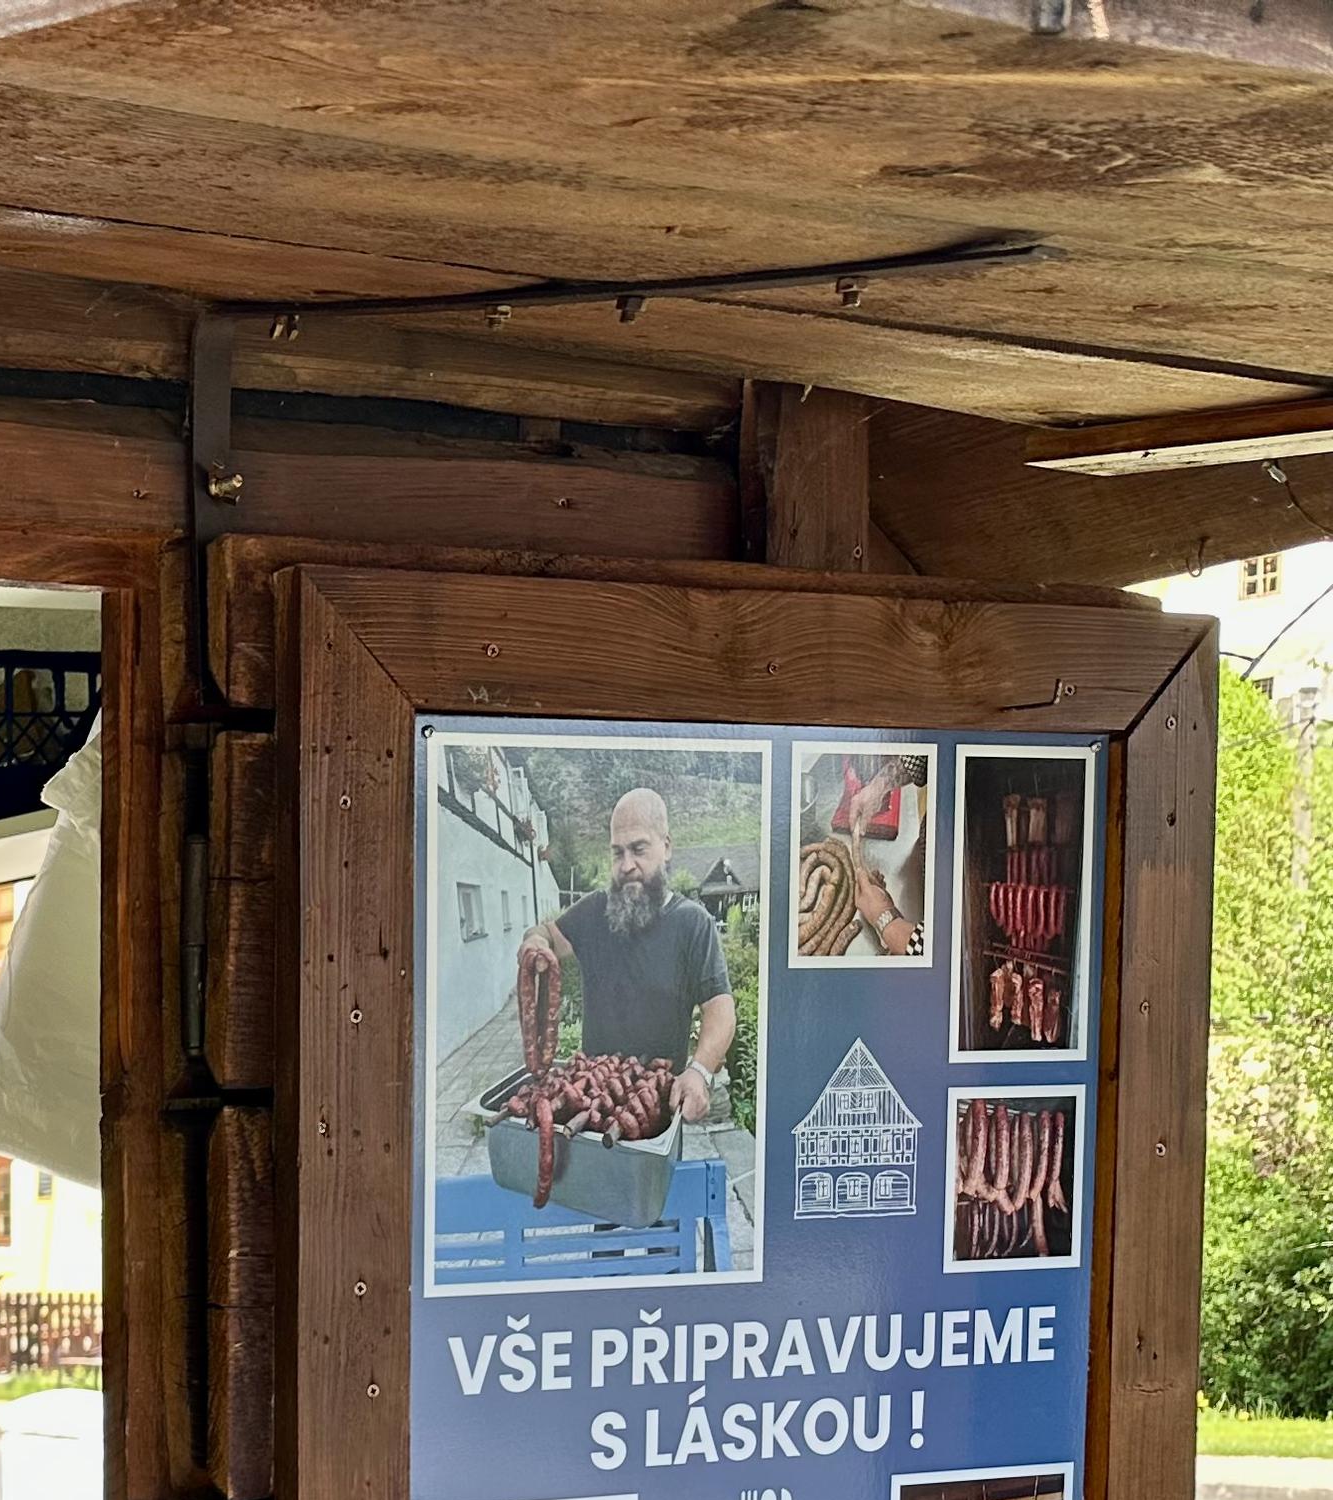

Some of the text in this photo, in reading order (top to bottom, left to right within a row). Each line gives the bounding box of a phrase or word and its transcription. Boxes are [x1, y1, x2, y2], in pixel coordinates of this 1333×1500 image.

[447, 1305, 1057, 1396] VŠE PŘIPRAVUJEME
[589, 1410, 627, 1471] S
[643, 1386, 892, 1468] LÁSKOU
